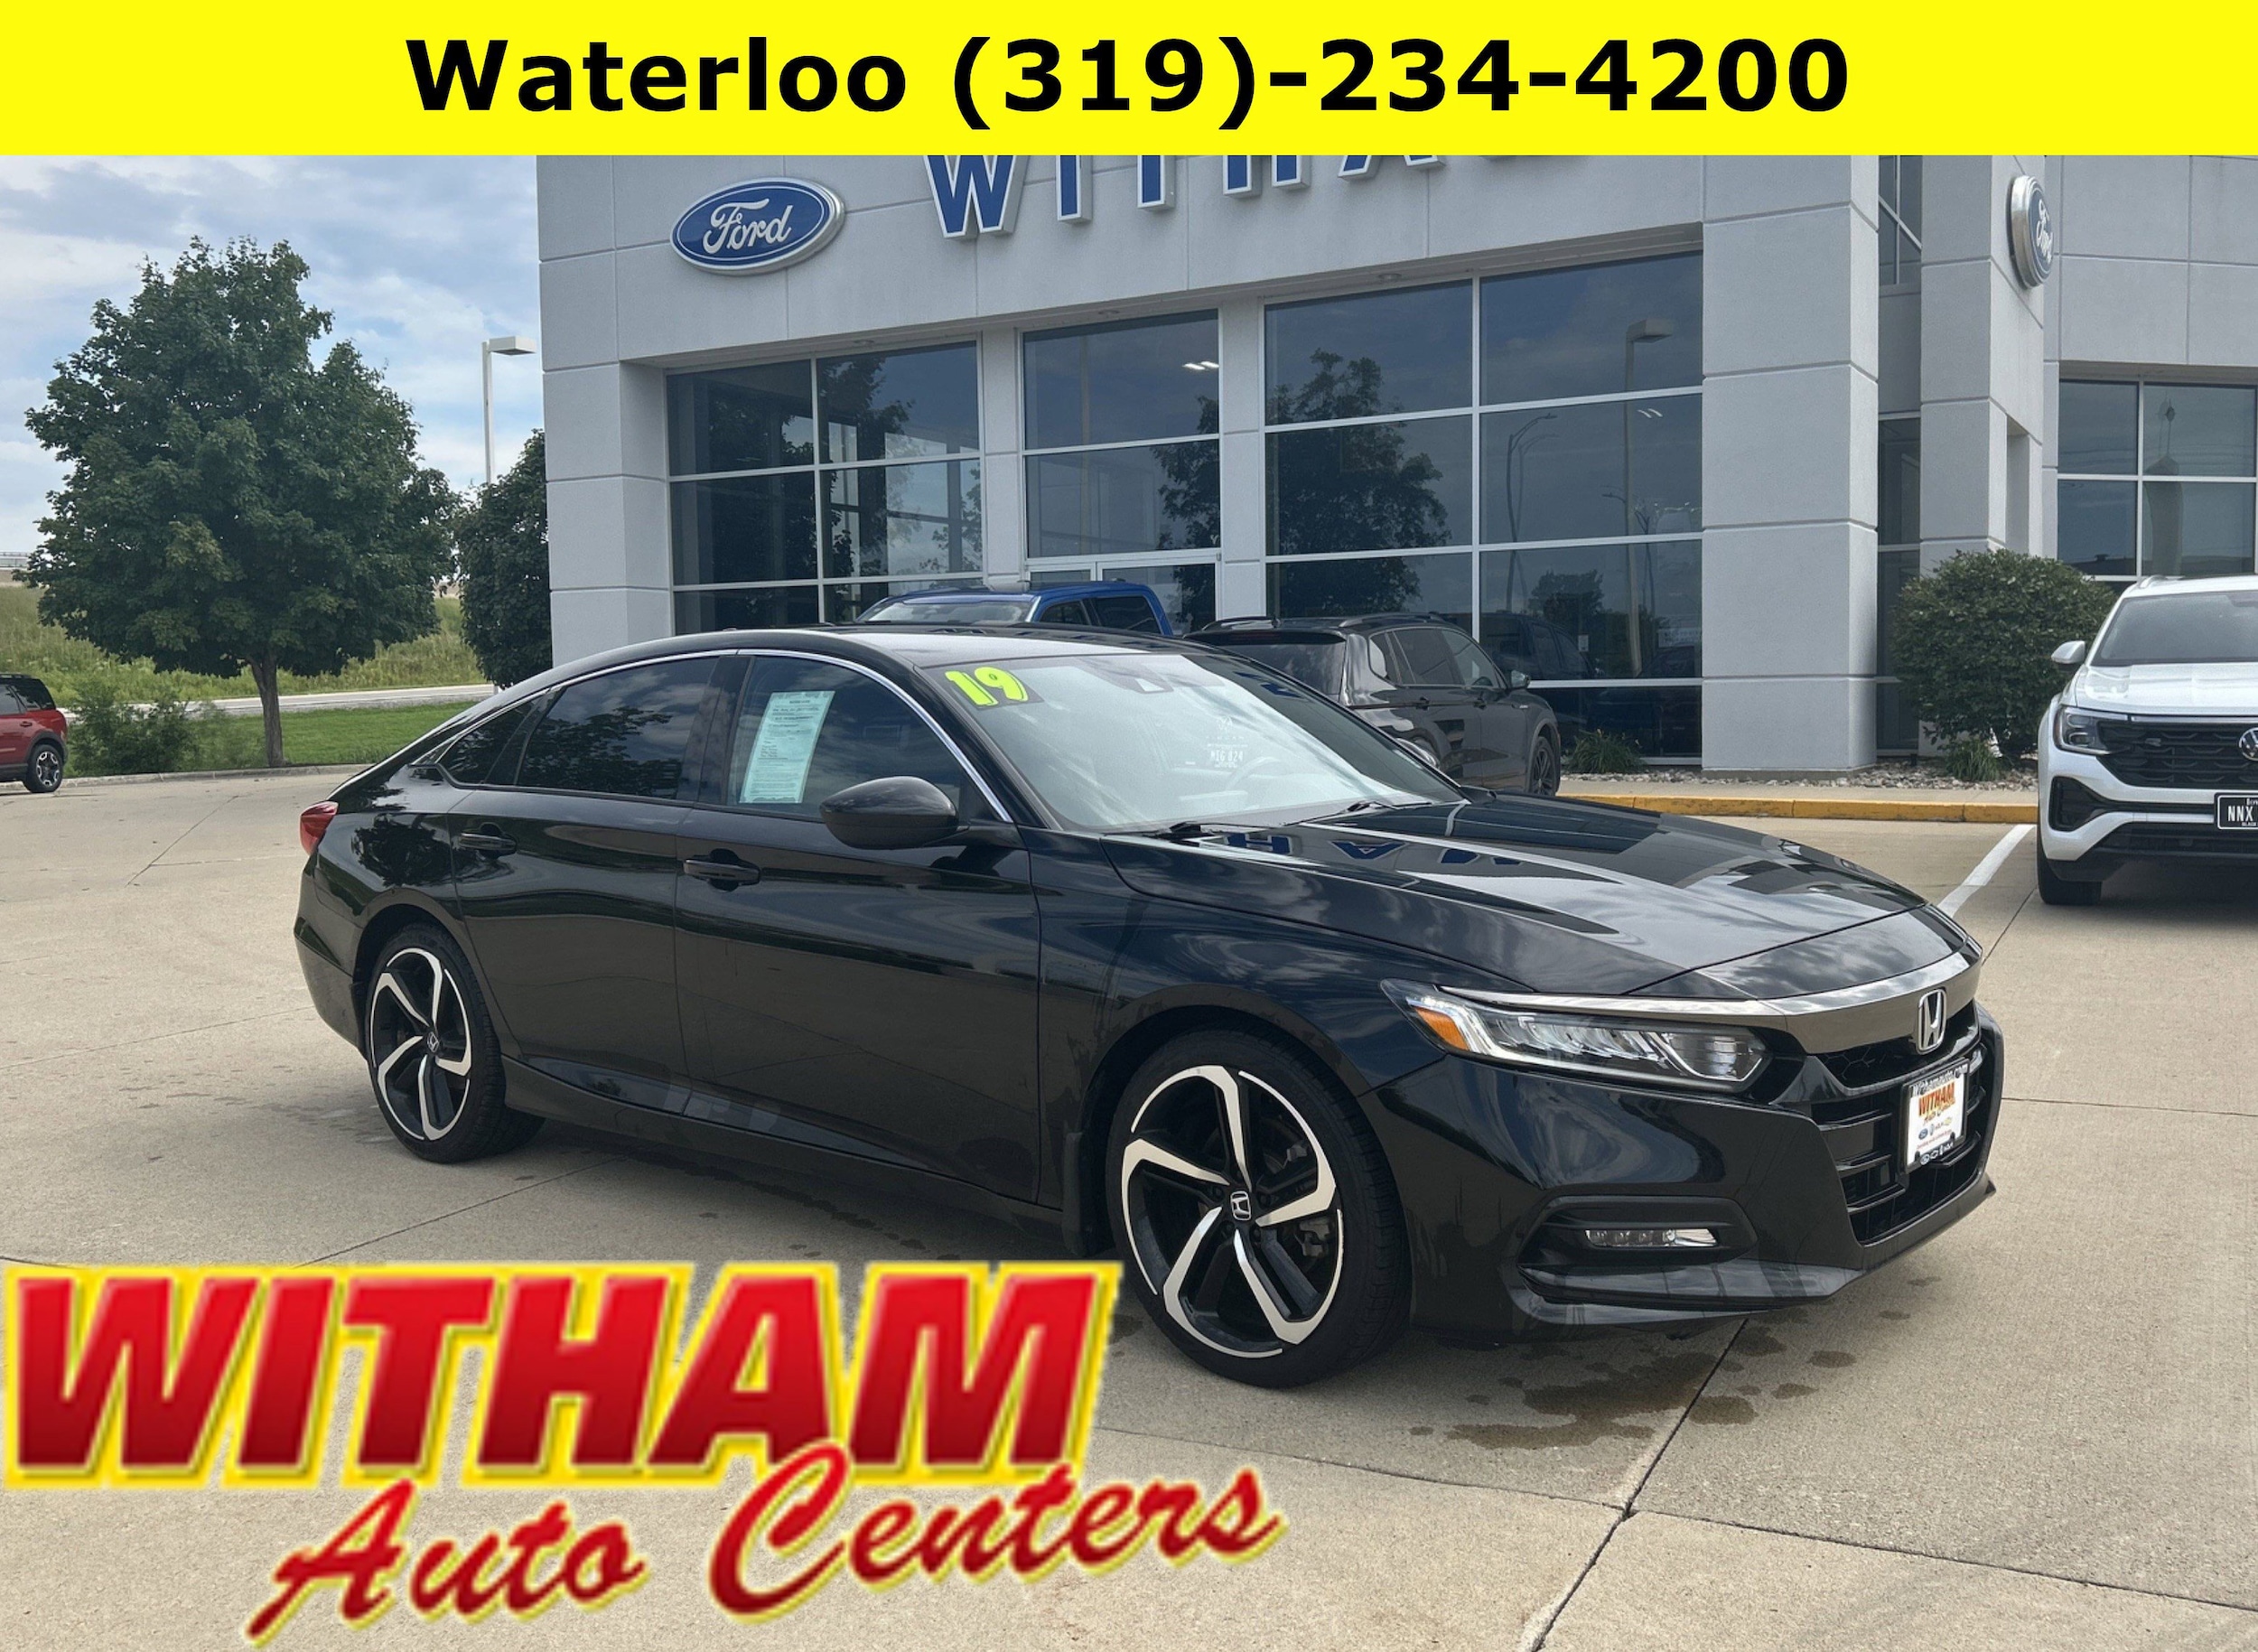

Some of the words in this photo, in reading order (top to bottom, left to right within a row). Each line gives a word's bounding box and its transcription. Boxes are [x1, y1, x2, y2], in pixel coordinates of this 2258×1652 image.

[703, 198, 794, 255] Ford
[944, 666, 1029, 706] 19
[2227, 806, 2253, 822] NNX
[1918, 1081, 1955, 1116] WITHAM
